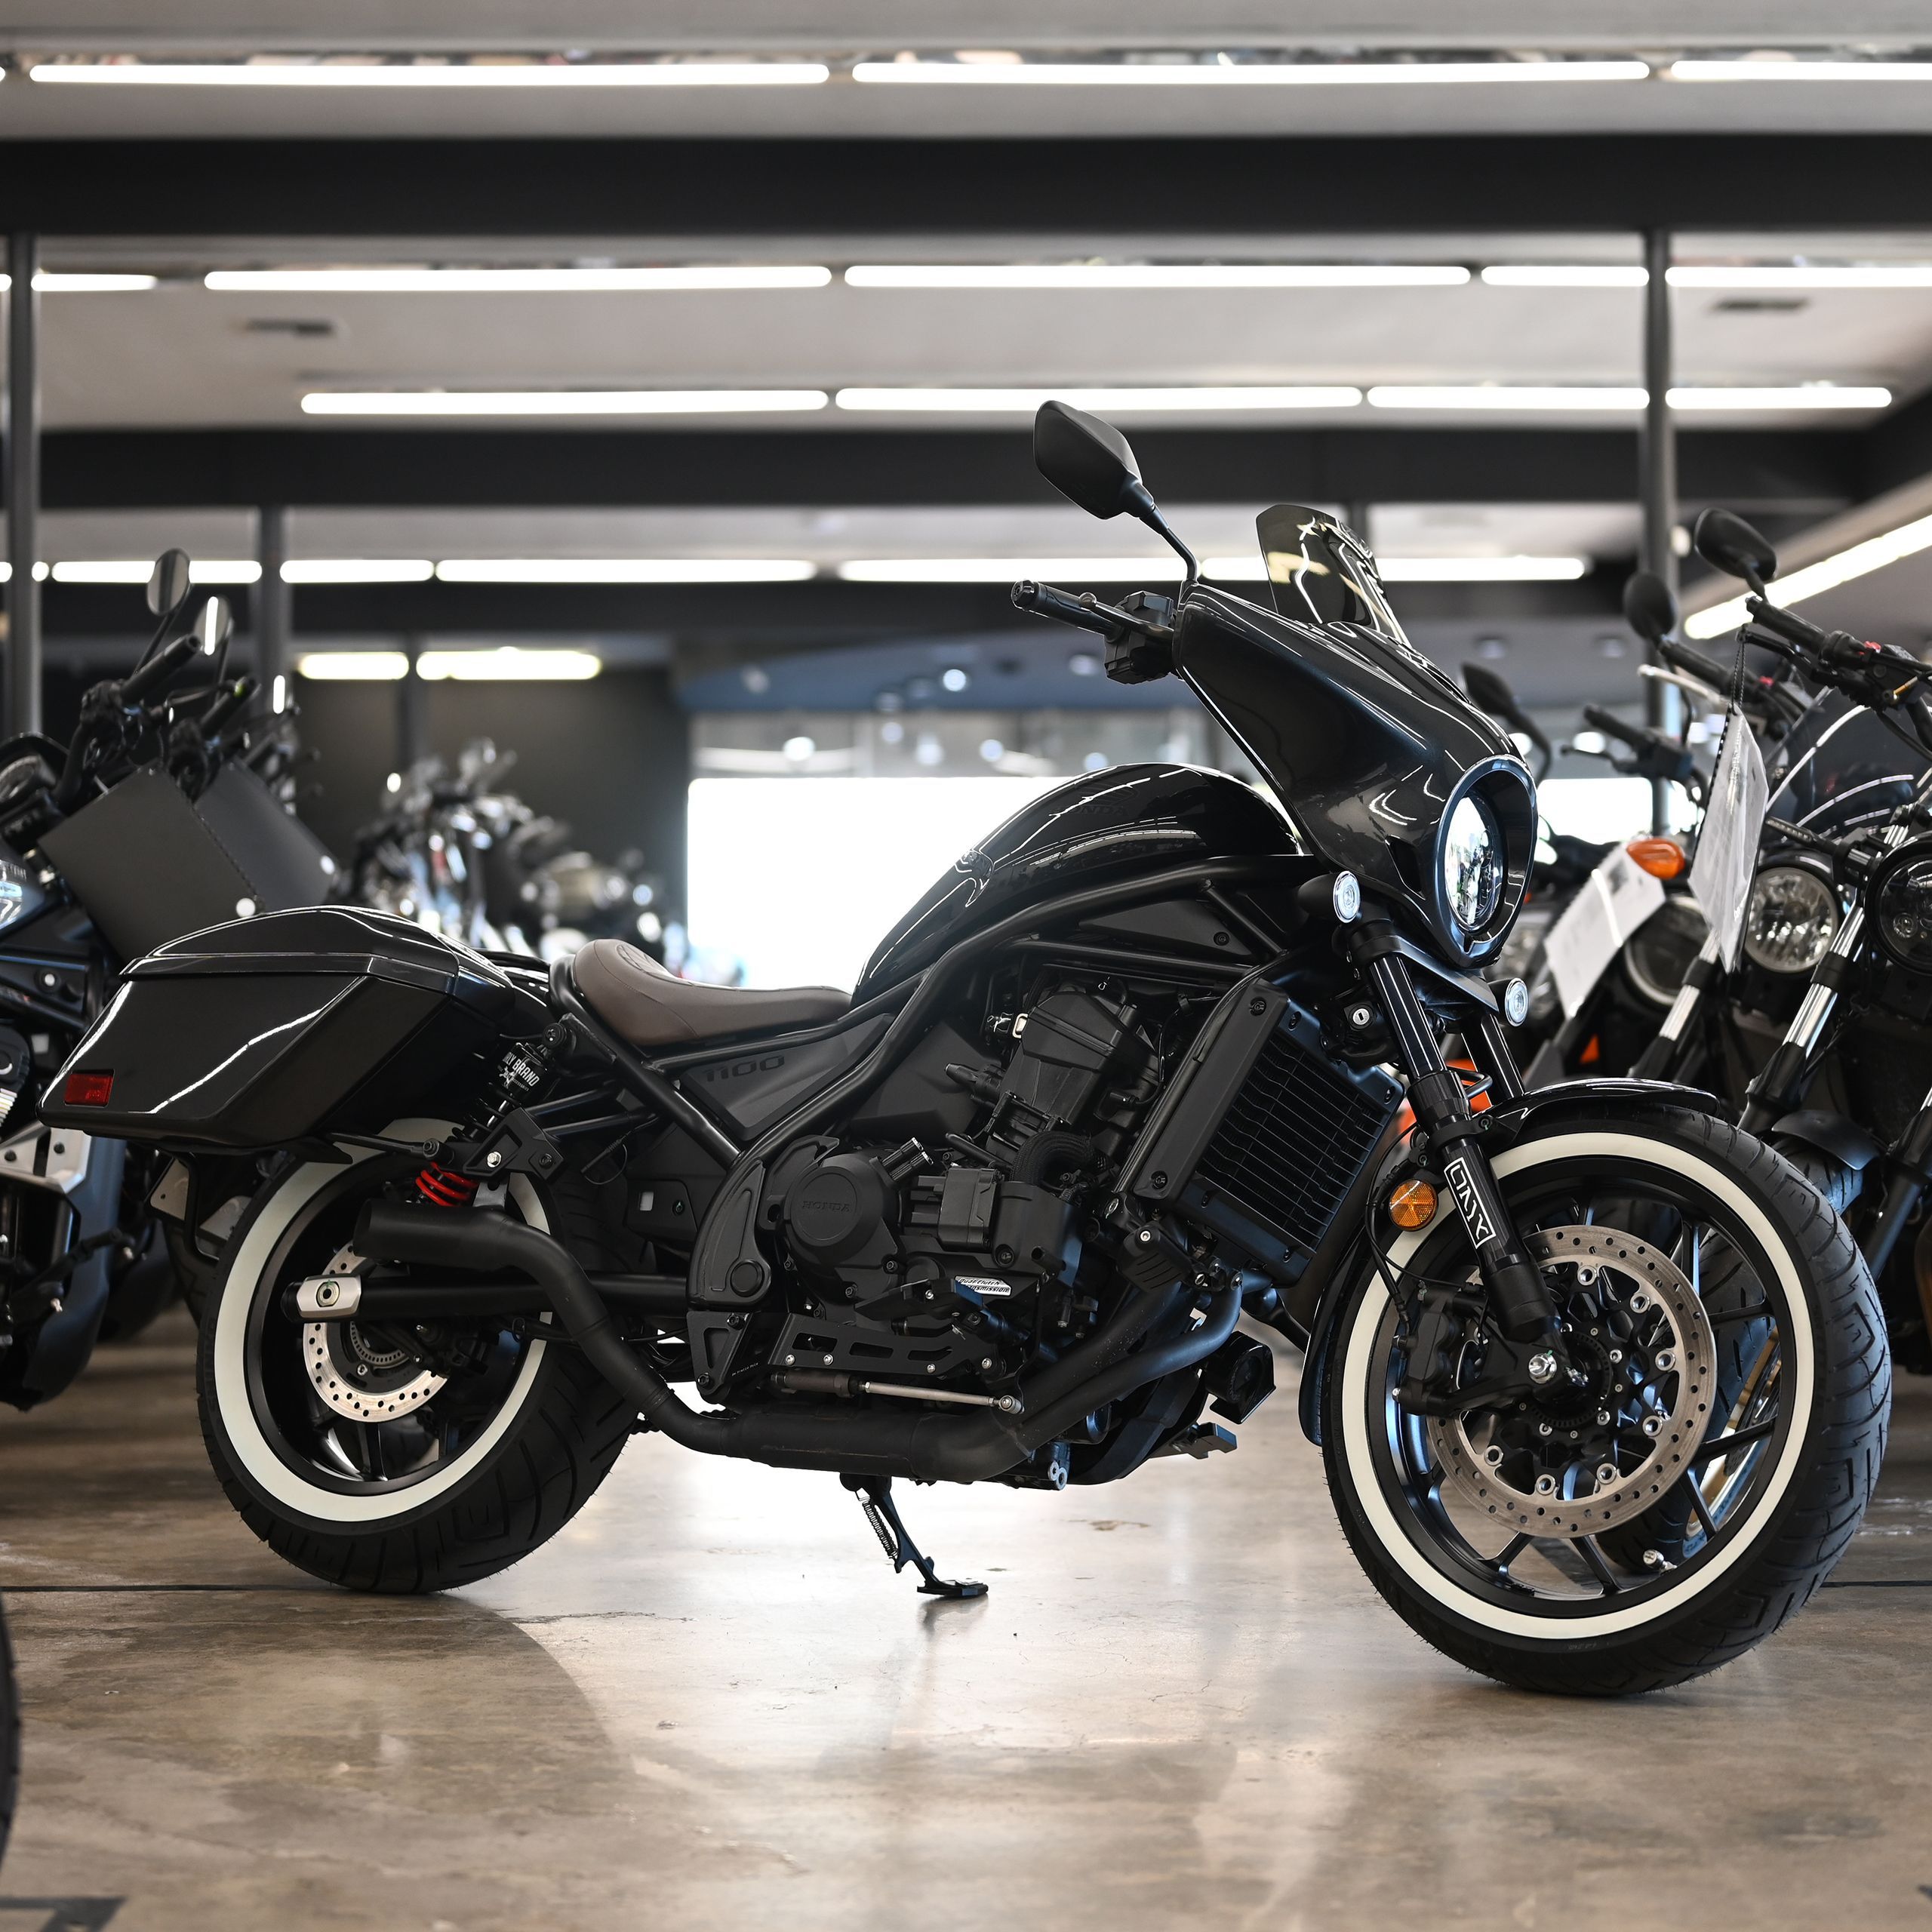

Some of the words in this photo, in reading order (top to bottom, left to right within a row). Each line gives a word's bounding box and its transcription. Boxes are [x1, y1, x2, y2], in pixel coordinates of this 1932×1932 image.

[512, 1059, 540, 1087] BRAND
[702, 1056, 785, 1082] 1100
[802, 1201, 851, 1213] HONDA
[1450, 1164, 1489, 1240] ONYX
